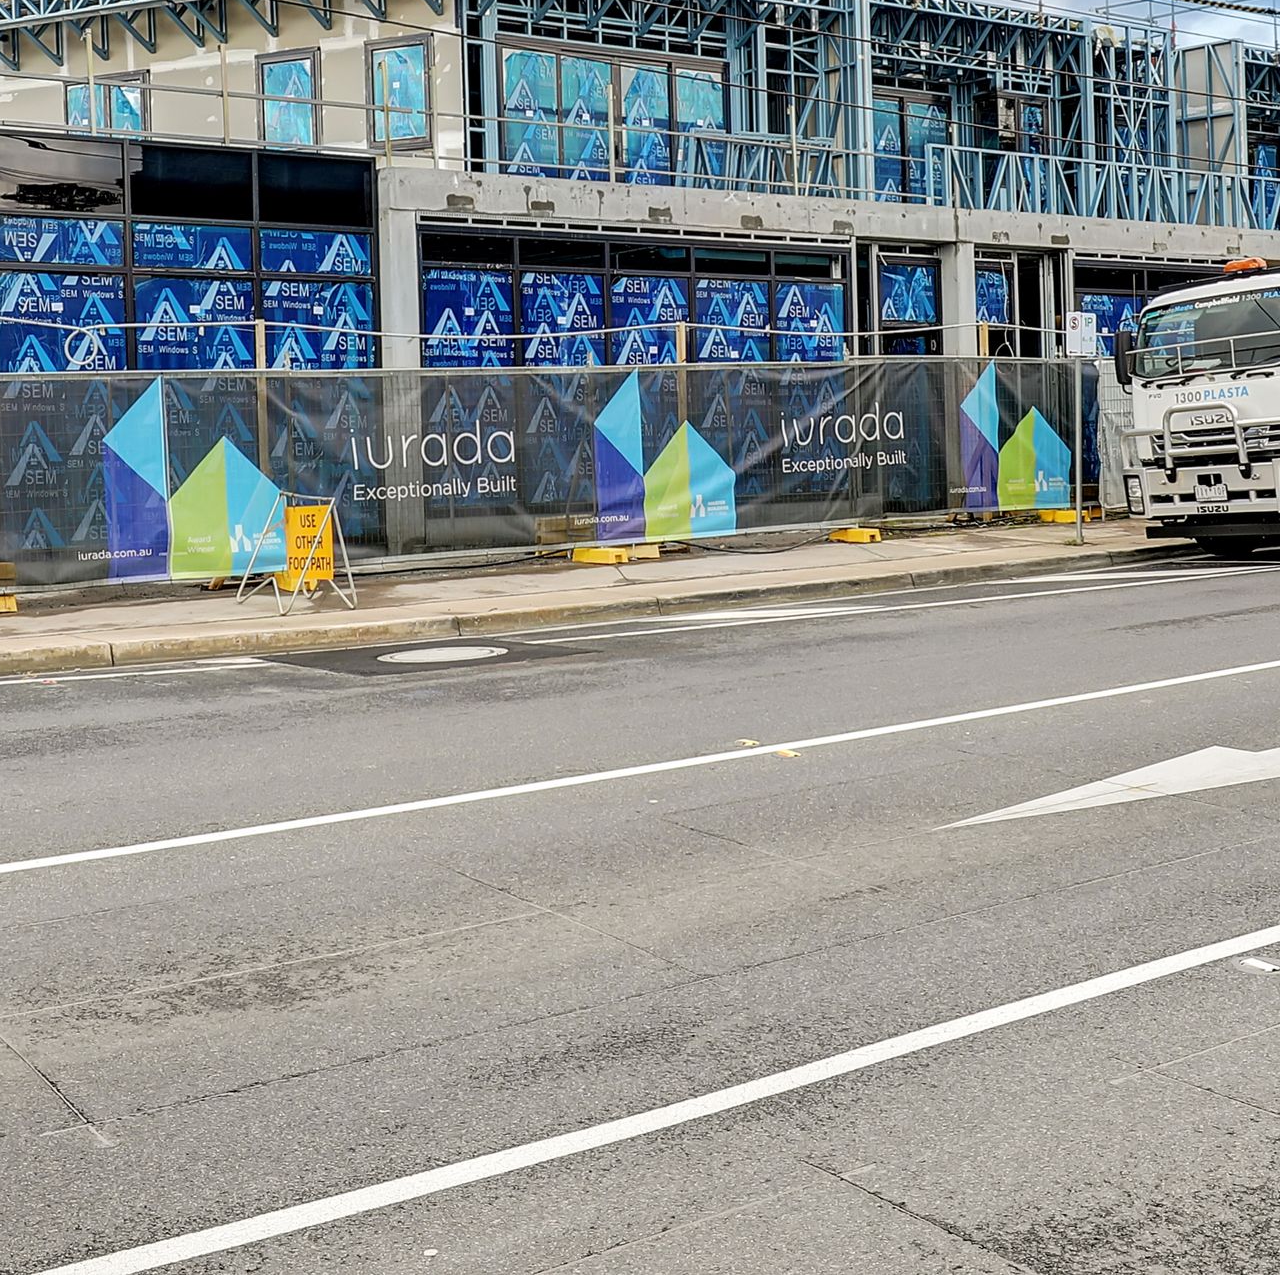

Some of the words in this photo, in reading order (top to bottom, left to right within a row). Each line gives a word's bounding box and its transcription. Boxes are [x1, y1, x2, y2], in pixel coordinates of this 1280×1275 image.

[335, 257, 362, 272] SEM
[81, 275, 112, 286] SEM
[627, 280, 649, 293] SEM
[61, 290, 77, 298] SEM
[82, 290, 114, 298] Windows
[118, 291, 123, 299] S
[281, 283, 310, 297] SEM
[19, 298, 51, 313] SEM
[215, 296, 245, 310] SEM
[263, 300, 278, 308] SEM
[283, 301, 311, 309] Windows
[628, 296, 651, 304] Windows
[1194, 295, 1240, 309] Campbellfield
[1241, 293, 1261, 301] 1300
[197, 314, 212, 322] SEM
[217, 314, 247, 322] Windows
[660, 308, 682, 320] SEM
[790, 306, 809, 317] SEM
[574, 315, 597, 328] SEM
[743, 314, 763, 326] SEM
[158, 326, 188, 341] SEM
[482, 333, 506, 346] SEM
[339, 336, 365, 350] SEM
[820, 336, 839, 347] SEM
[138, 345, 154, 353] SEM
[159, 345, 189, 354] Windows
[192, 346, 198, 354] S
[538, 345, 561, 358] SEM
[711, 346, 732, 357] SEM
[86, 355, 116, 370] SEM
[340, 354, 367, 363] Windows
[629, 352, 651, 364] SEM
[22, 383, 54, 399] SEM
[219, 378, 247, 391] SEM
[744, 383, 765, 395] SEM
[1175, 391, 1201, 404] 1300
[1204, 386, 1249, 400] PLASTA
[1, 403, 19, 412] SEM
[483, 409, 508, 422] SEM
[1190, 414, 1234, 425] ISUZU
[780, 401, 904, 447] iurada
[349, 418, 515, 470] iurada
[782, 453, 873, 473] Exceptionally
[877, 450, 907, 466] Built
[25, 470, 57, 485] SEM
[353, 480, 471, 501] Exceptionally
[477, 476, 516, 494] Built
[1197, 505, 1229, 513] ISUZU
[300, 514, 316, 528] USE
[574, 514, 629, 526] iurada.com.au
[187, 535, 211, 544] Award
[296, 535, 323, 549] OTHER
[78, 547, 152, 561] iurada.com.au
[288, 557, 331, 570] FOOTPATH
